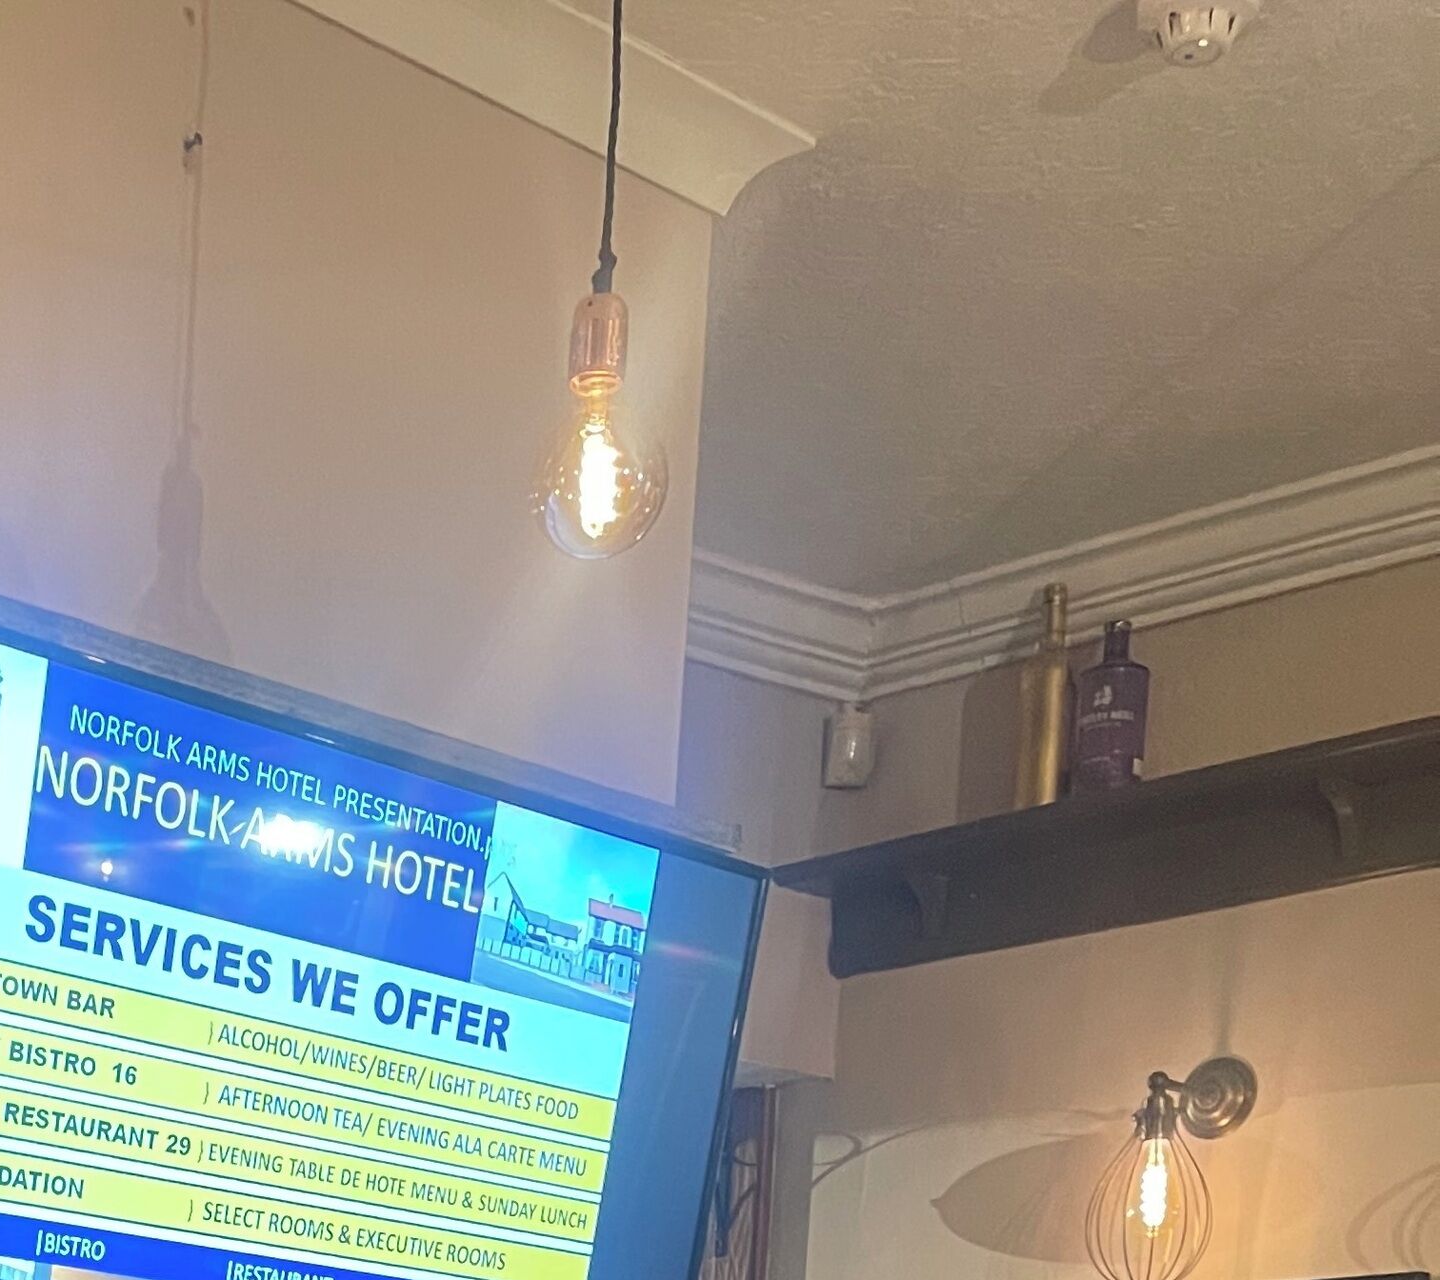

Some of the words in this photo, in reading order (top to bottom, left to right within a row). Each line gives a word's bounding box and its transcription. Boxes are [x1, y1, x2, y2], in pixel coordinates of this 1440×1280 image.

[70, 704, 182, 763] NORFOLK
[186, 741, 249, 782] ARMS
[256, 761, 326, 806] HOTEL
[36, 745, 235, 845] NORFOLK
[366, 840, 479, 914] HOTEL
[25, 894, 272, 994] SERVICES
[291, 958, 359, 1015] WE
[373, 982, 510, 1052] OFFER
[66, 990, 115, 1018] BAR
[9, 1040, 96, 1077] BISTRO
[111, 1063, 137, 1086] 16
[428, 1070, 475, 1098] LIGHT
[478, 1081, 532, 1110] PLATES
[535, 1093, 579, 1121] FOOD
[3, 1102, 159, 1150] RESTAURANT
[164, 1133, 191, 1156] 29
[217, 1084, 328, 1126] AFTERNOON
[332, 1108, 374, 1138] TEA/
[377, 1117, 449, 1150] EVENING
[451, 1132, 484, 1157] ALA
[487, 1140, 536, 1167] CARTE
[538, 1151, 587, 1177] MENU
[207, 1142, 284, 1175] EVENING
[288, 1157, 335, 1184] TABLE
[340, 1168, 362, 1188] DE
[365, 1173, 407, 1198] HOTE
[410, 1181, 459, 1207] MENU
[461, 1190, 474, 1209] &
[477, 1193, 539, 1222] SUNDAY
[540, 1205, 588, 1230] LUNCH
[201, 1200, 265, 1229] SELECT
[268, 1210, 334, 1244] ROOMS
[338, 1223, 351, 1244] &
[355, 1227, 444, 1260] EXECUTIVE
[446, 1243, 507, 1271] ROOMS
